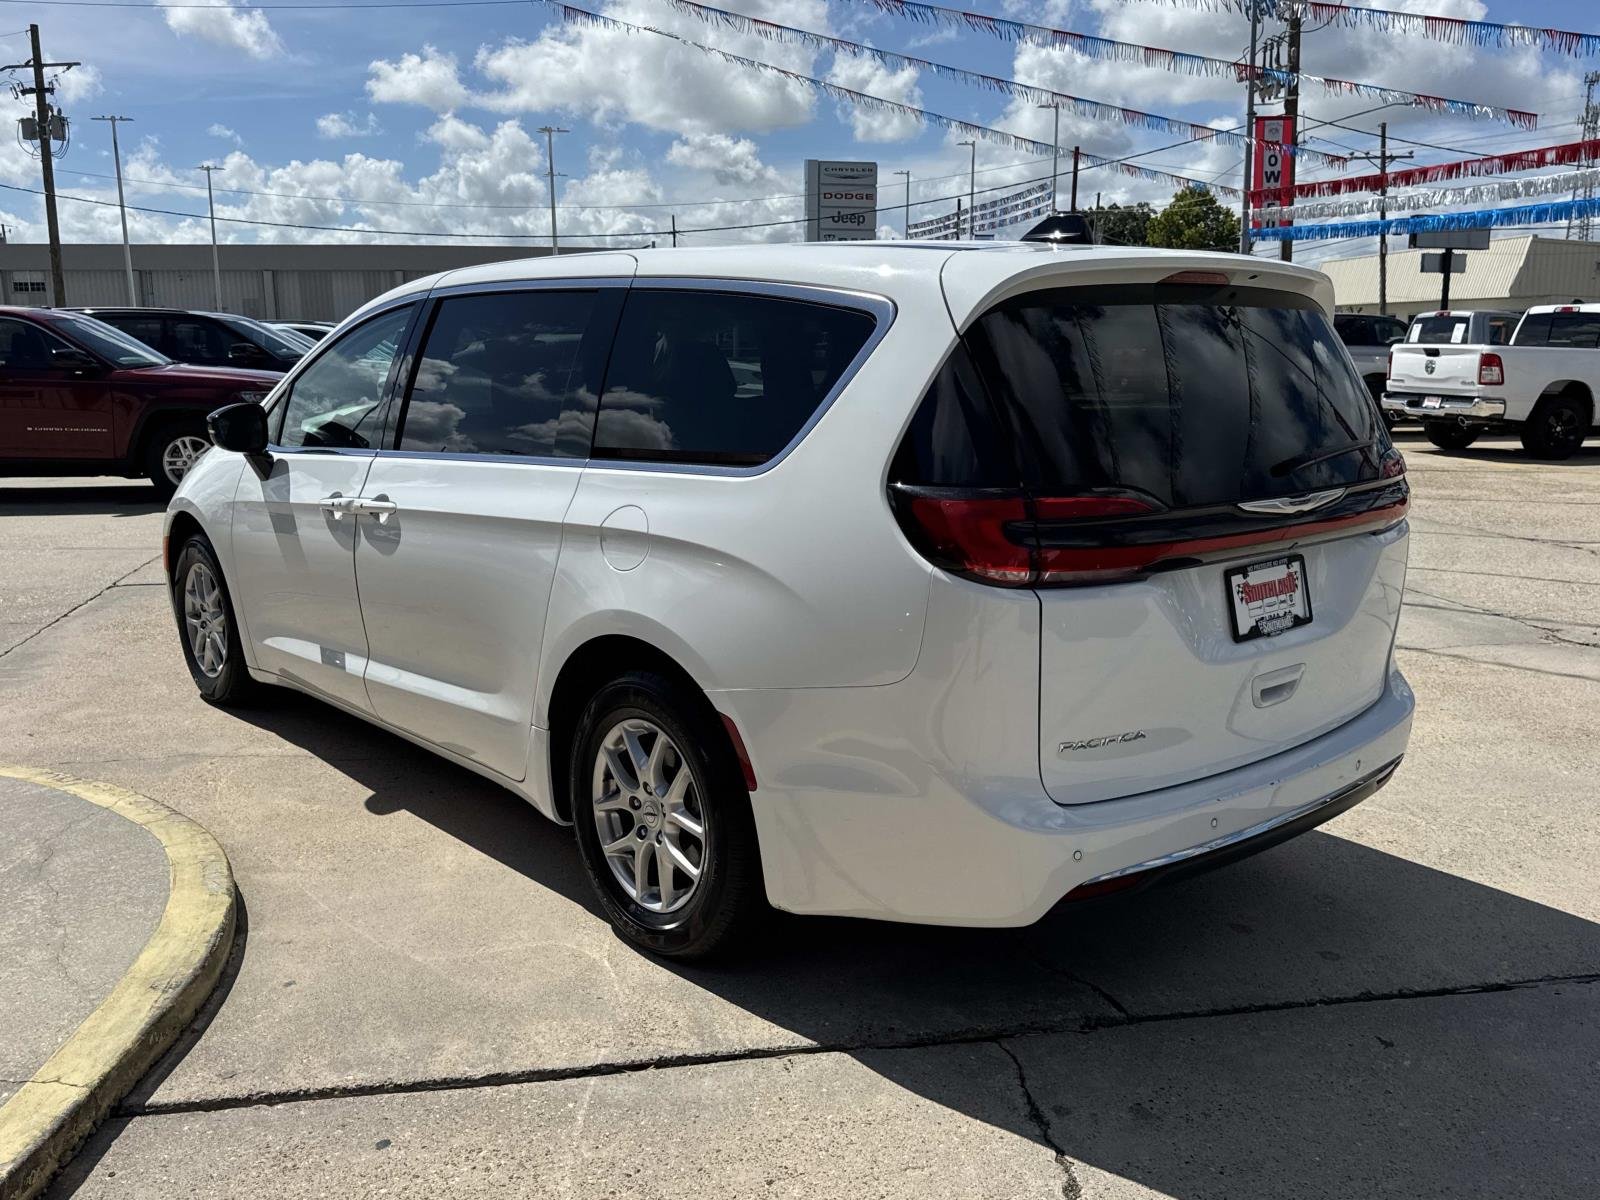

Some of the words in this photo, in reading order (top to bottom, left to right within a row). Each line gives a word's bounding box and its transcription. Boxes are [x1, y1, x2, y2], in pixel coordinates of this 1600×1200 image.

[823, 192, 874, 200] DODGE
[831, 210, 866, 226] Jeep
[1243, 571, 1296, 604] SOUTHLAND
[1059, 729, 1146, 753] PACIFICA
